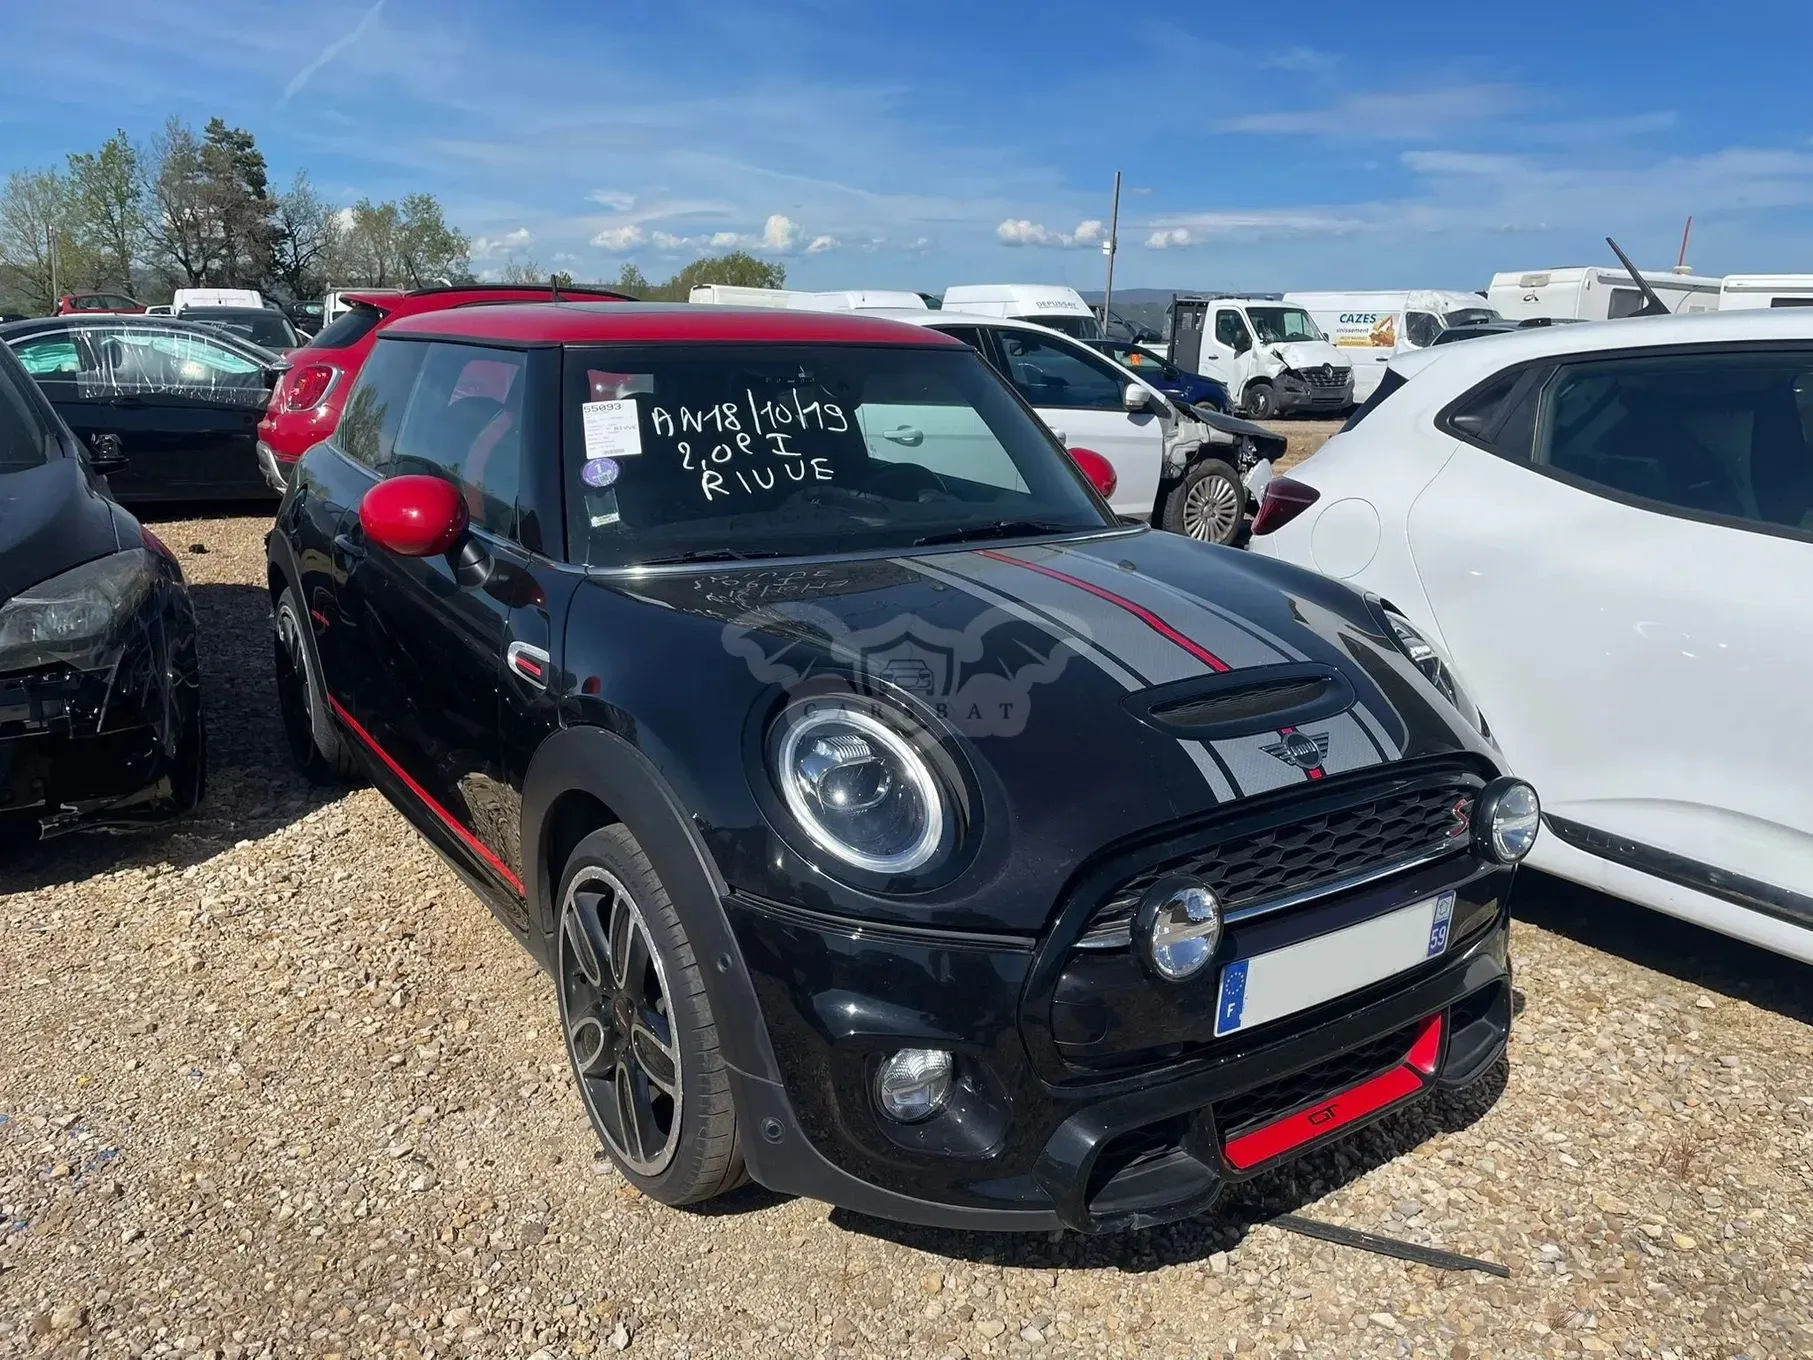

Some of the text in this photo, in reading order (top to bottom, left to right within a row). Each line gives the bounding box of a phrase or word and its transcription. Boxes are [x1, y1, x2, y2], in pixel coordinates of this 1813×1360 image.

[1339, 313, 1377, 324] CAZES
[583, 402, 622, 413] 55093
[1430, 925, 1447, 949] 59
[1227, 1003, 1235, 1018] F
[1308, 1103, 1338, 1126] GT
